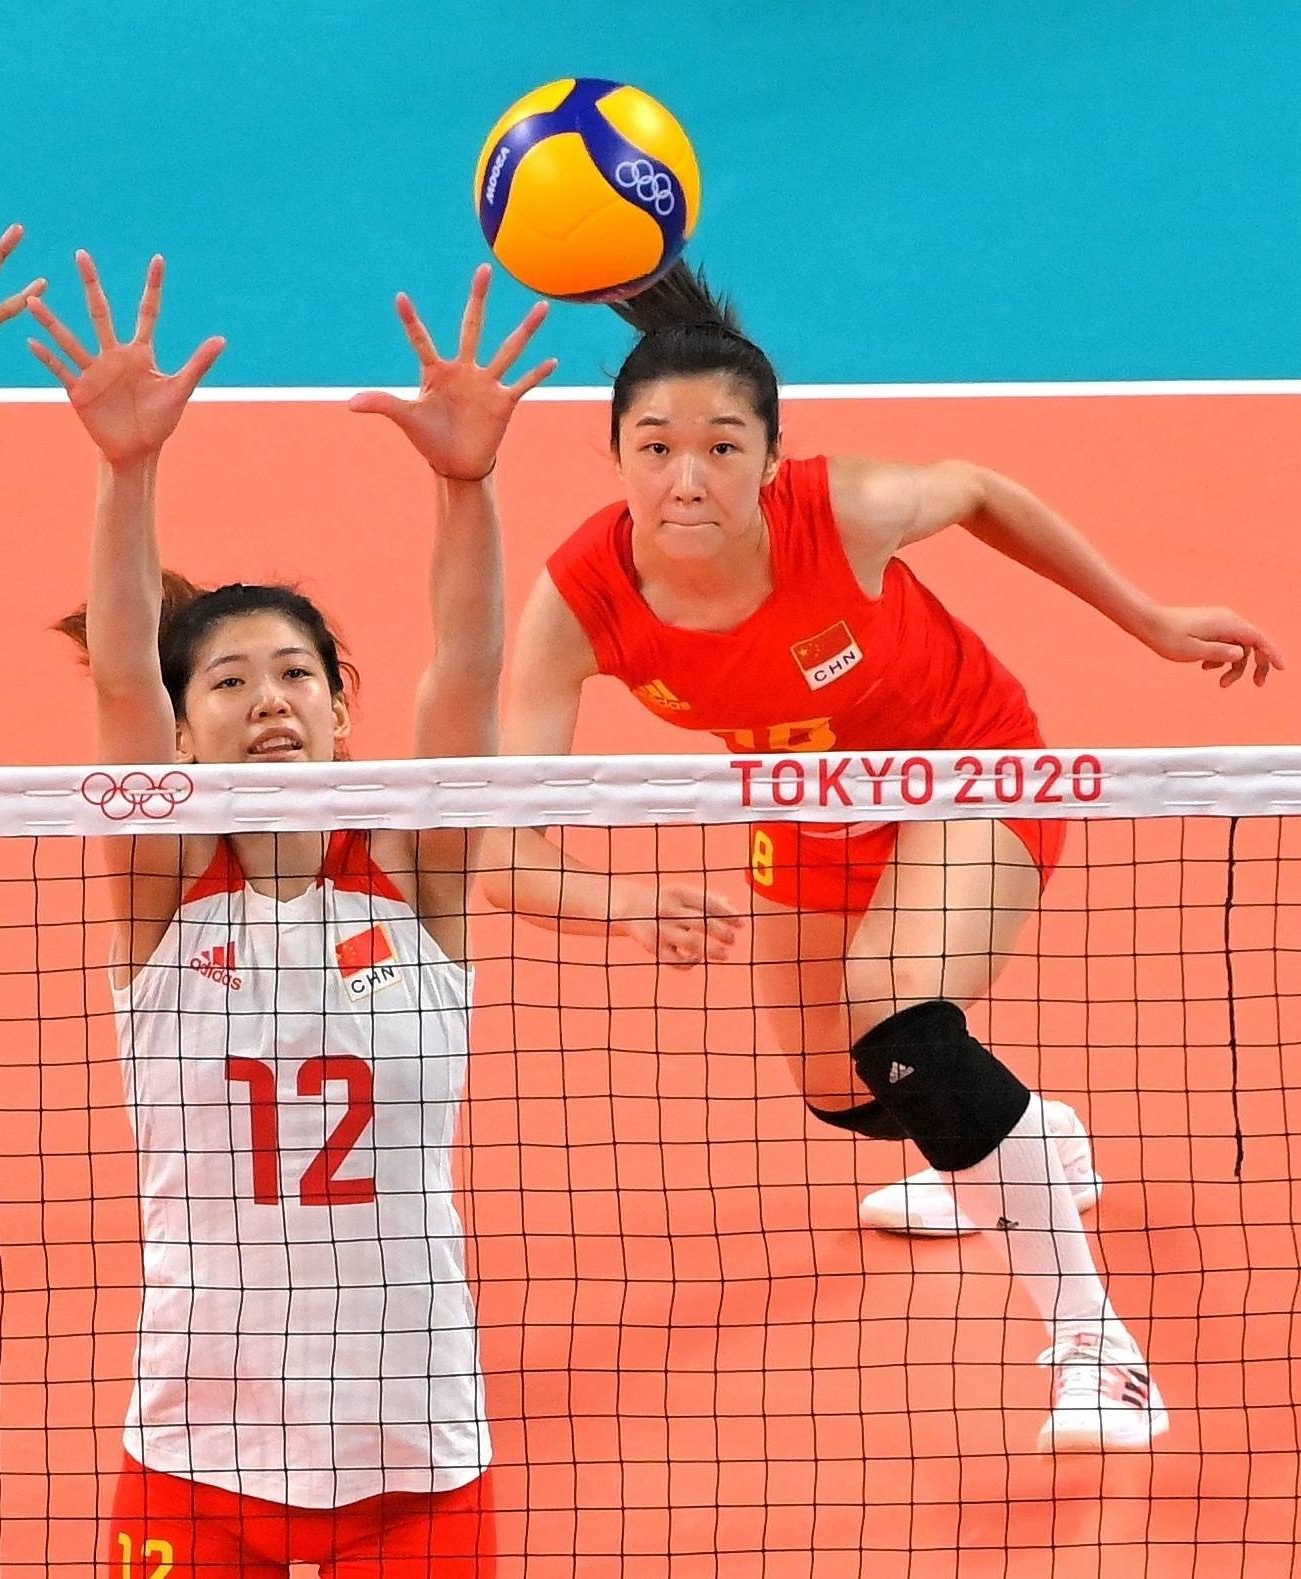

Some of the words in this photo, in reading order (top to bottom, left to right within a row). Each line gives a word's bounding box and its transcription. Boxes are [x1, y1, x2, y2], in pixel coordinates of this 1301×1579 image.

[486, 147, 510, 205] V200W
[813, 650, 856, 683] CHN
[730, 757, 934, 807] TOKYO
[954, 754, 1102, 804] 2020
[190, 956, 243, 992] adidas
[350, 966, 395, 994] CHN
[224, 1055, 377, 1207] 12
